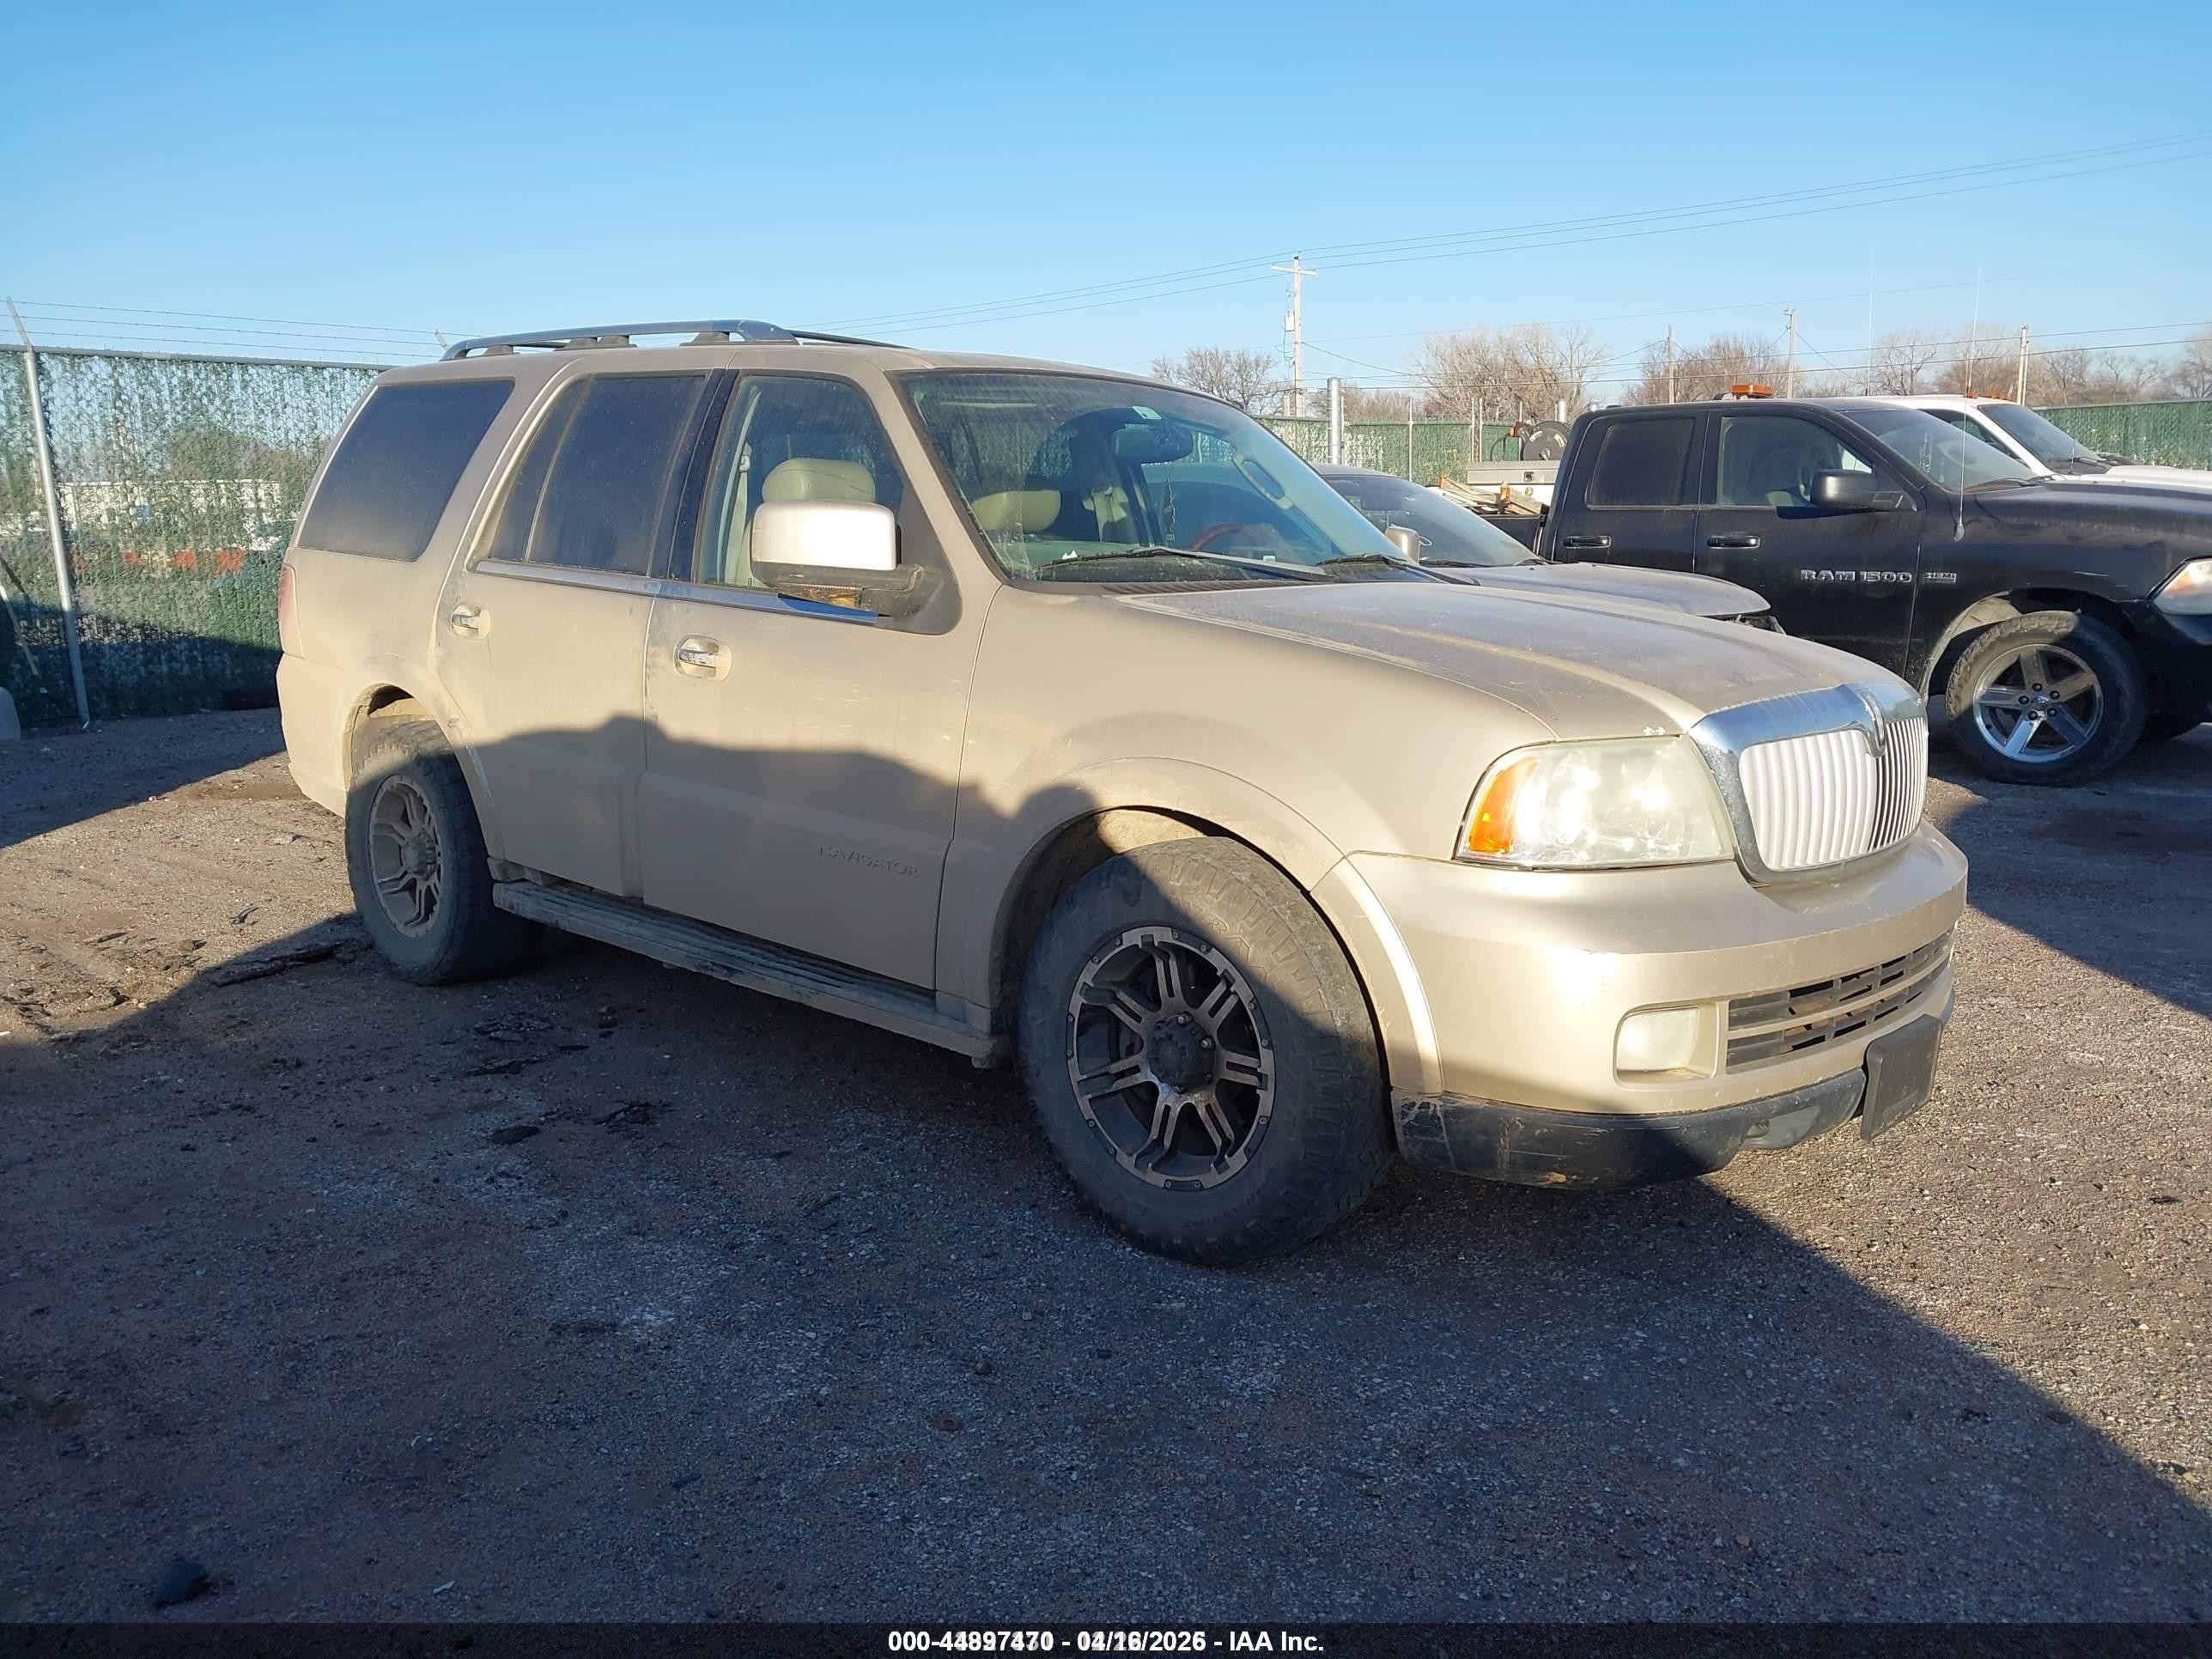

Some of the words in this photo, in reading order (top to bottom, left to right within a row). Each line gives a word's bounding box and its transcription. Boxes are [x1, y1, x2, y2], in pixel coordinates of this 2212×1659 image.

[1800, 568, 1856, 582] RAM
[1860, 570, 1912, 583] 1500
[1924, 571, 1958, 581] HEMI
[819, 846, 920, 878] NAVIGATOR
